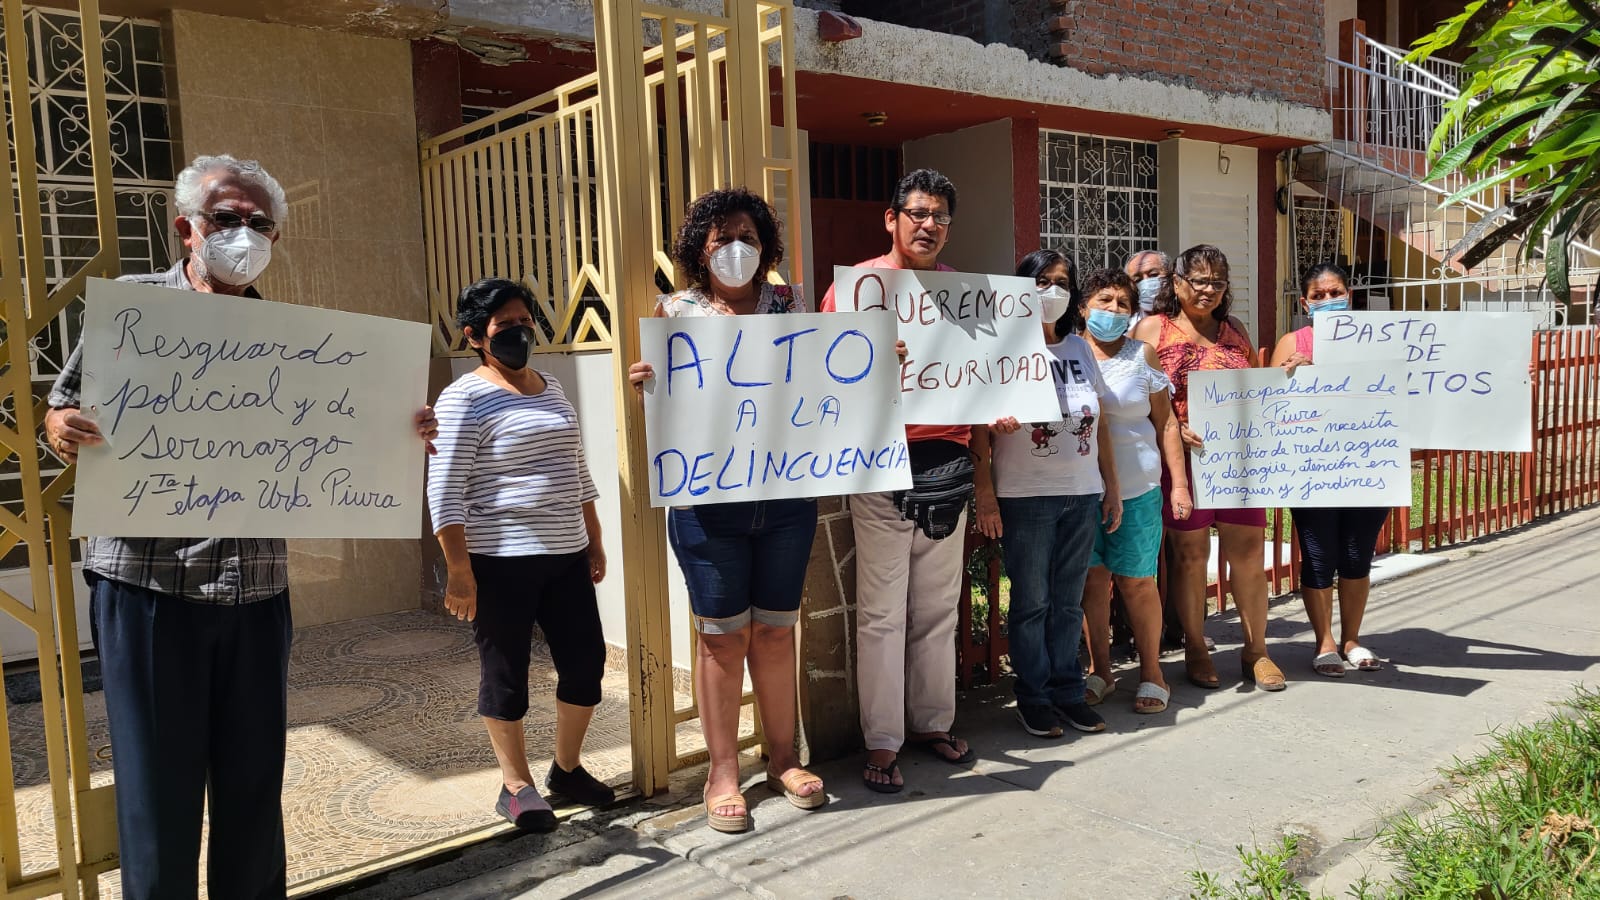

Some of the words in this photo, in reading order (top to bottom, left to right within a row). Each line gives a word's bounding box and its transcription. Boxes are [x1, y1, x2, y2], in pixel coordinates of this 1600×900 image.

[854, 273, 1033, 326] QUEREMOS
[113, 307, 367, 380] Resguardo
[1324, 314, 1437, 343] BASTA
[667, 328, 874, 397] ALTO
[1406, 344, 1446, 362] DE
[901, 353, 1048, 392] EGURIDAD
[1049, 359, 1088, 385] VE
[102, 366, 284, 435] policial
[294, 400, 316, 425] y
[327, 388, 356, 419] de
[1205, 376, 1350, 405] Municipalidad
[1367, 374, 1397, 395] de
[736, 399, 757, 432] A
[791, 395, 841, 427] LA
[1262, 400, 1322, 425] Piura
[1203, 421, 1221, 442] la
[1228, 420, 1262, 440] Urb.
[1264, 421, 1318, 437] Piura
[1271, 440, 1290, 457] de
[1294, 437, 1340, 454] redes
[1343, 438, 1399, 458] agua
[654, 441, 908, 497] DELINCUENCIA
[1201, 470, 1216, 489] y
[1365, 459, 1400, 469] en
[167, 475, 245, 521] etapa
[258, 476, 312, 510] Urb.
[321, 468, 401, 509] Piura
[1205, 484, 1274, 505] parques
[1279, 483, 1294, 499] y
[1300, 475, 1386, 500] jardines
